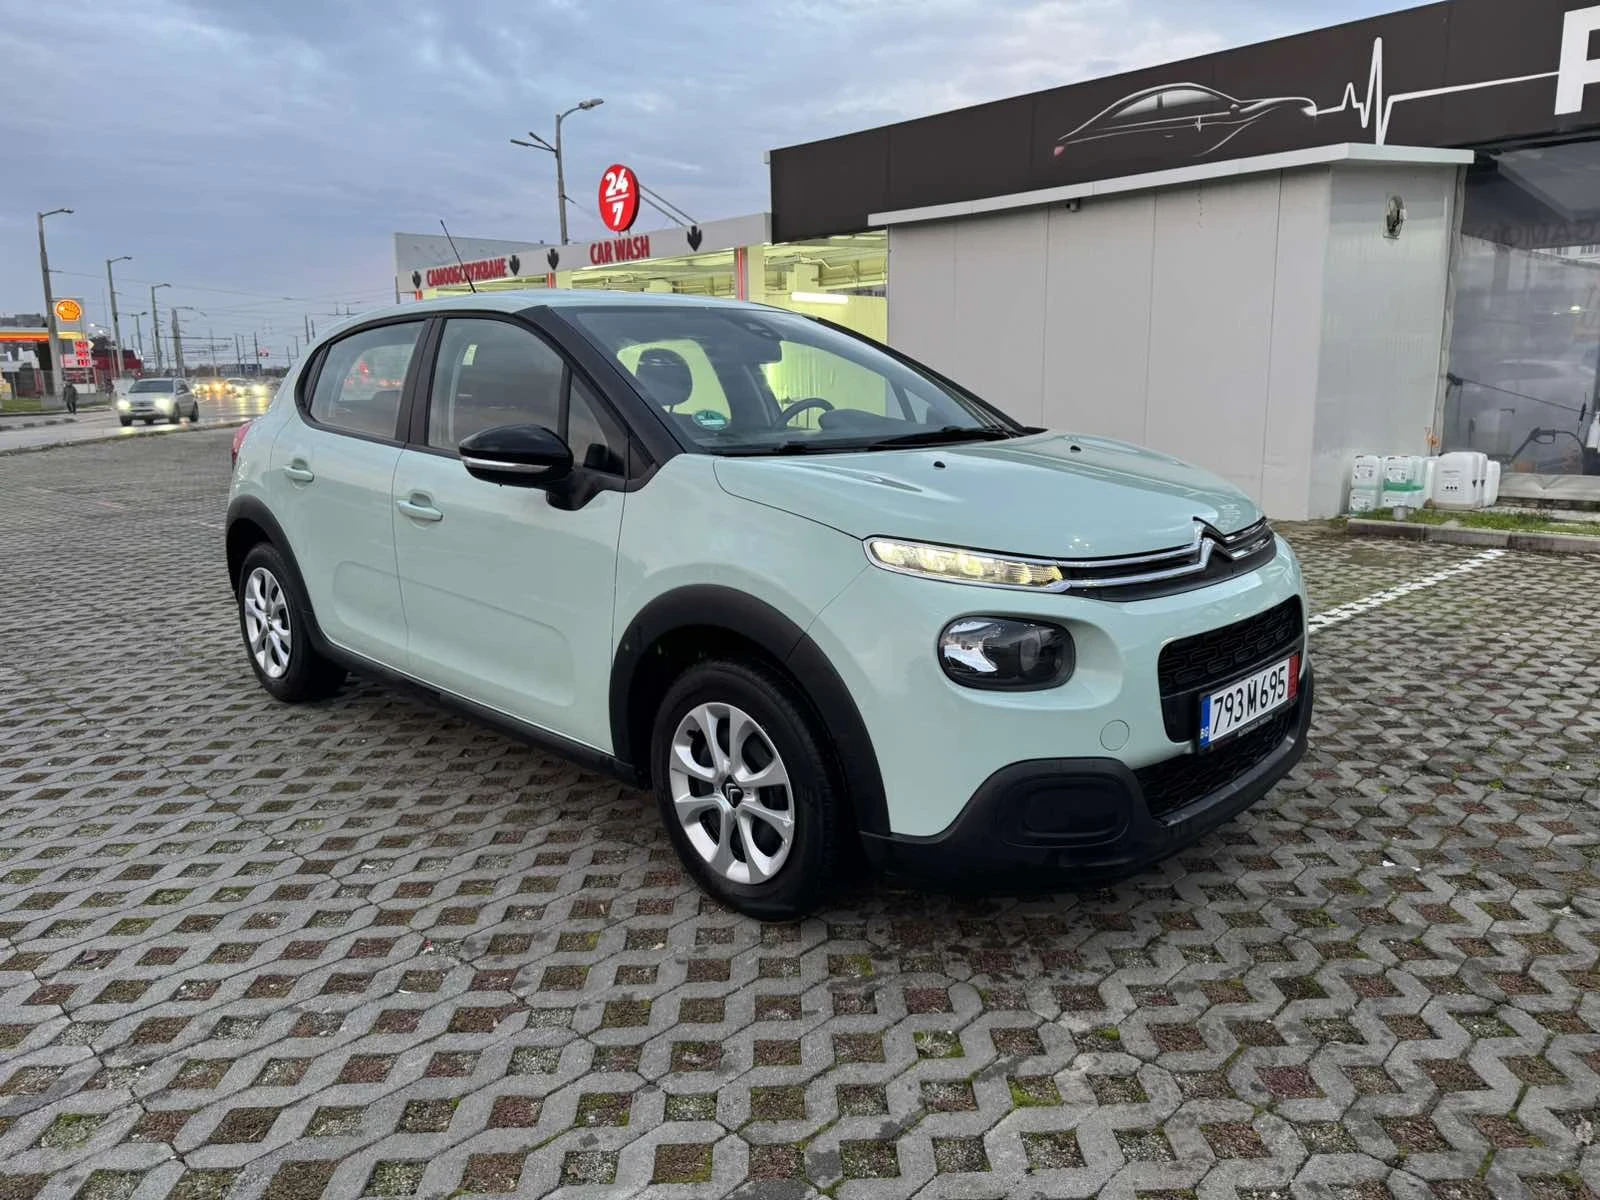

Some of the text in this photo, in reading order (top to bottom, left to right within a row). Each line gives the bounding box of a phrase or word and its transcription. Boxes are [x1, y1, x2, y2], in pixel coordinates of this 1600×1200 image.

[605, 168, 629, 197] 24
[612, 201, 624, 226] 7
[590, 235, 650, 265] CAR WASH
[1213, 665, 1286, 735] 793M695
